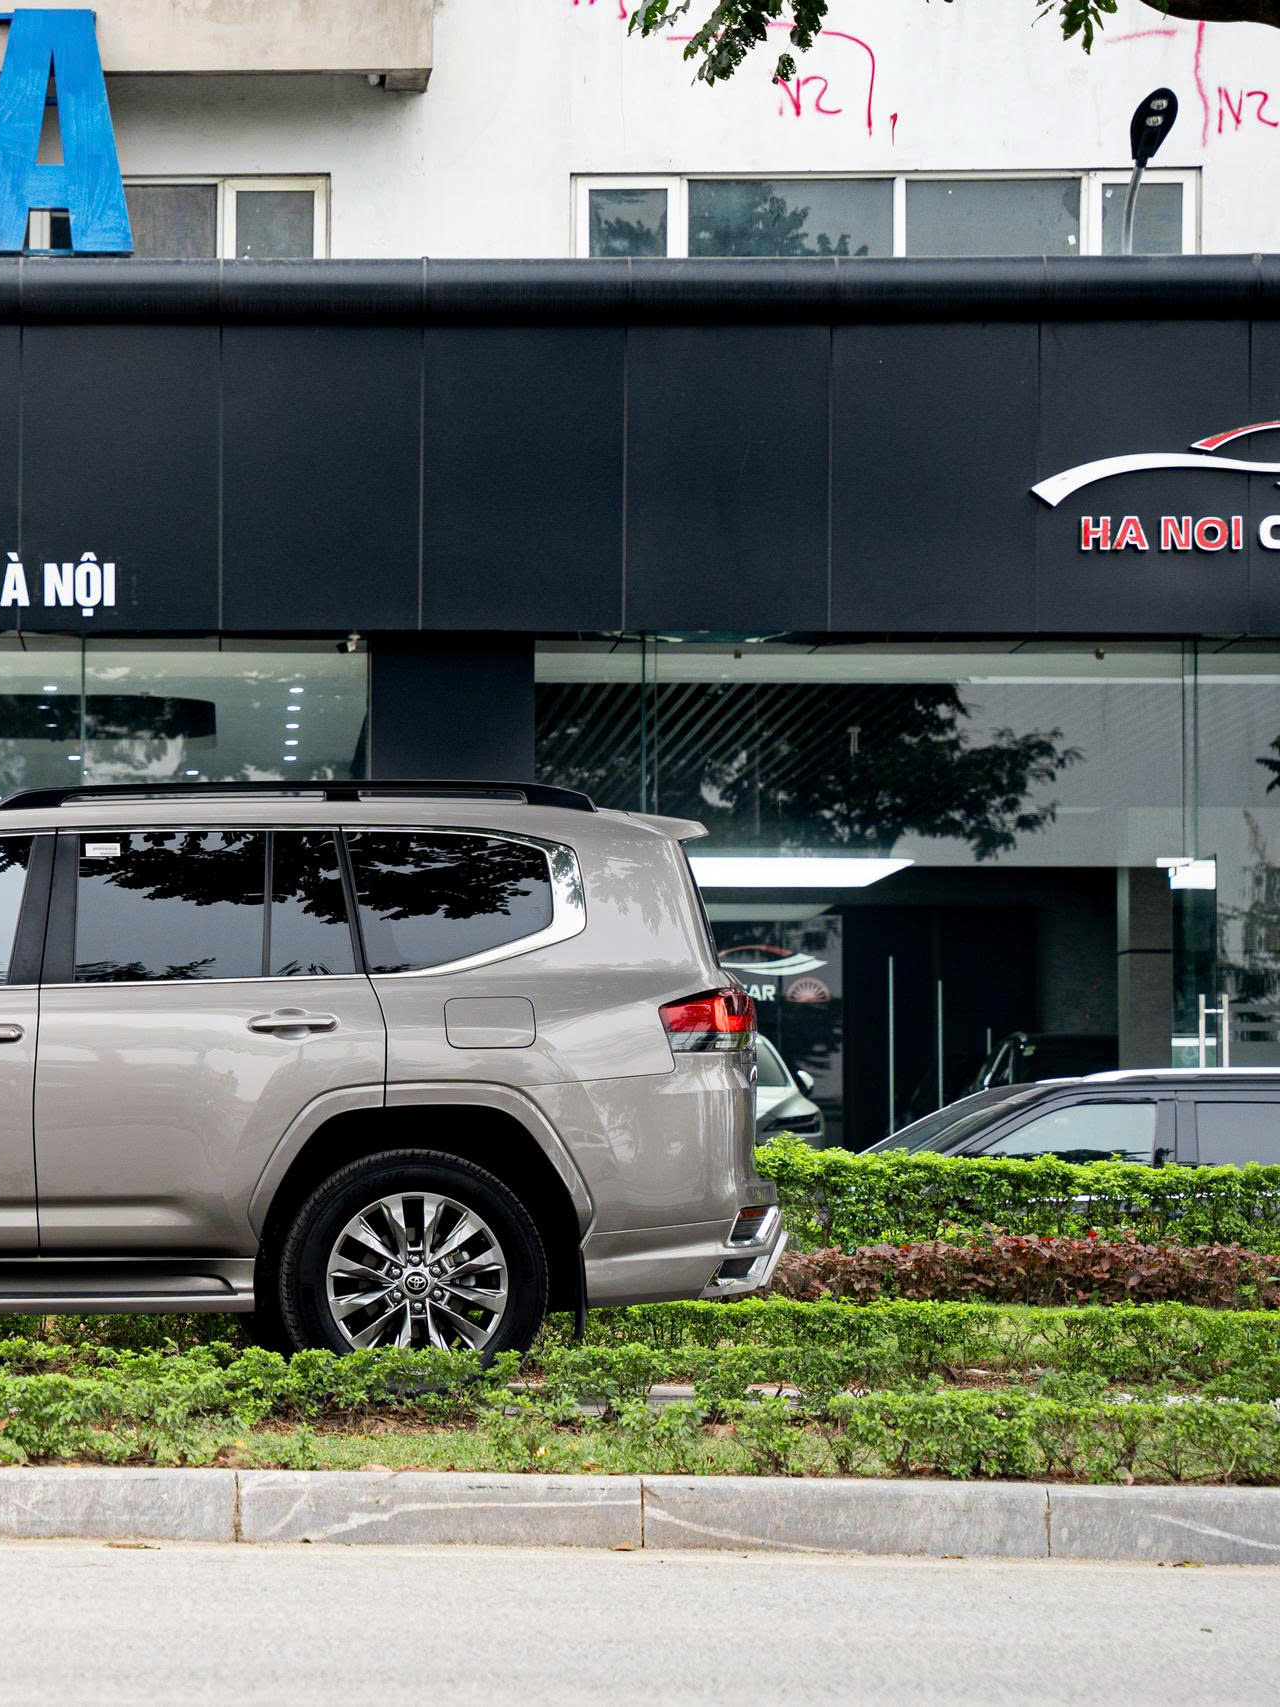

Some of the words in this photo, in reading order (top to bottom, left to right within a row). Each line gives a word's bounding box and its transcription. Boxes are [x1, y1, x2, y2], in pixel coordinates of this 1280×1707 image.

[1217, 86, 1279, 134] N2
[1081, 515, 1149, 550] HA
[1160, 515, 1243, 551] NOI
[43, 551, 116, 617] NỘI
[743, 984, 776, 1002] AR
